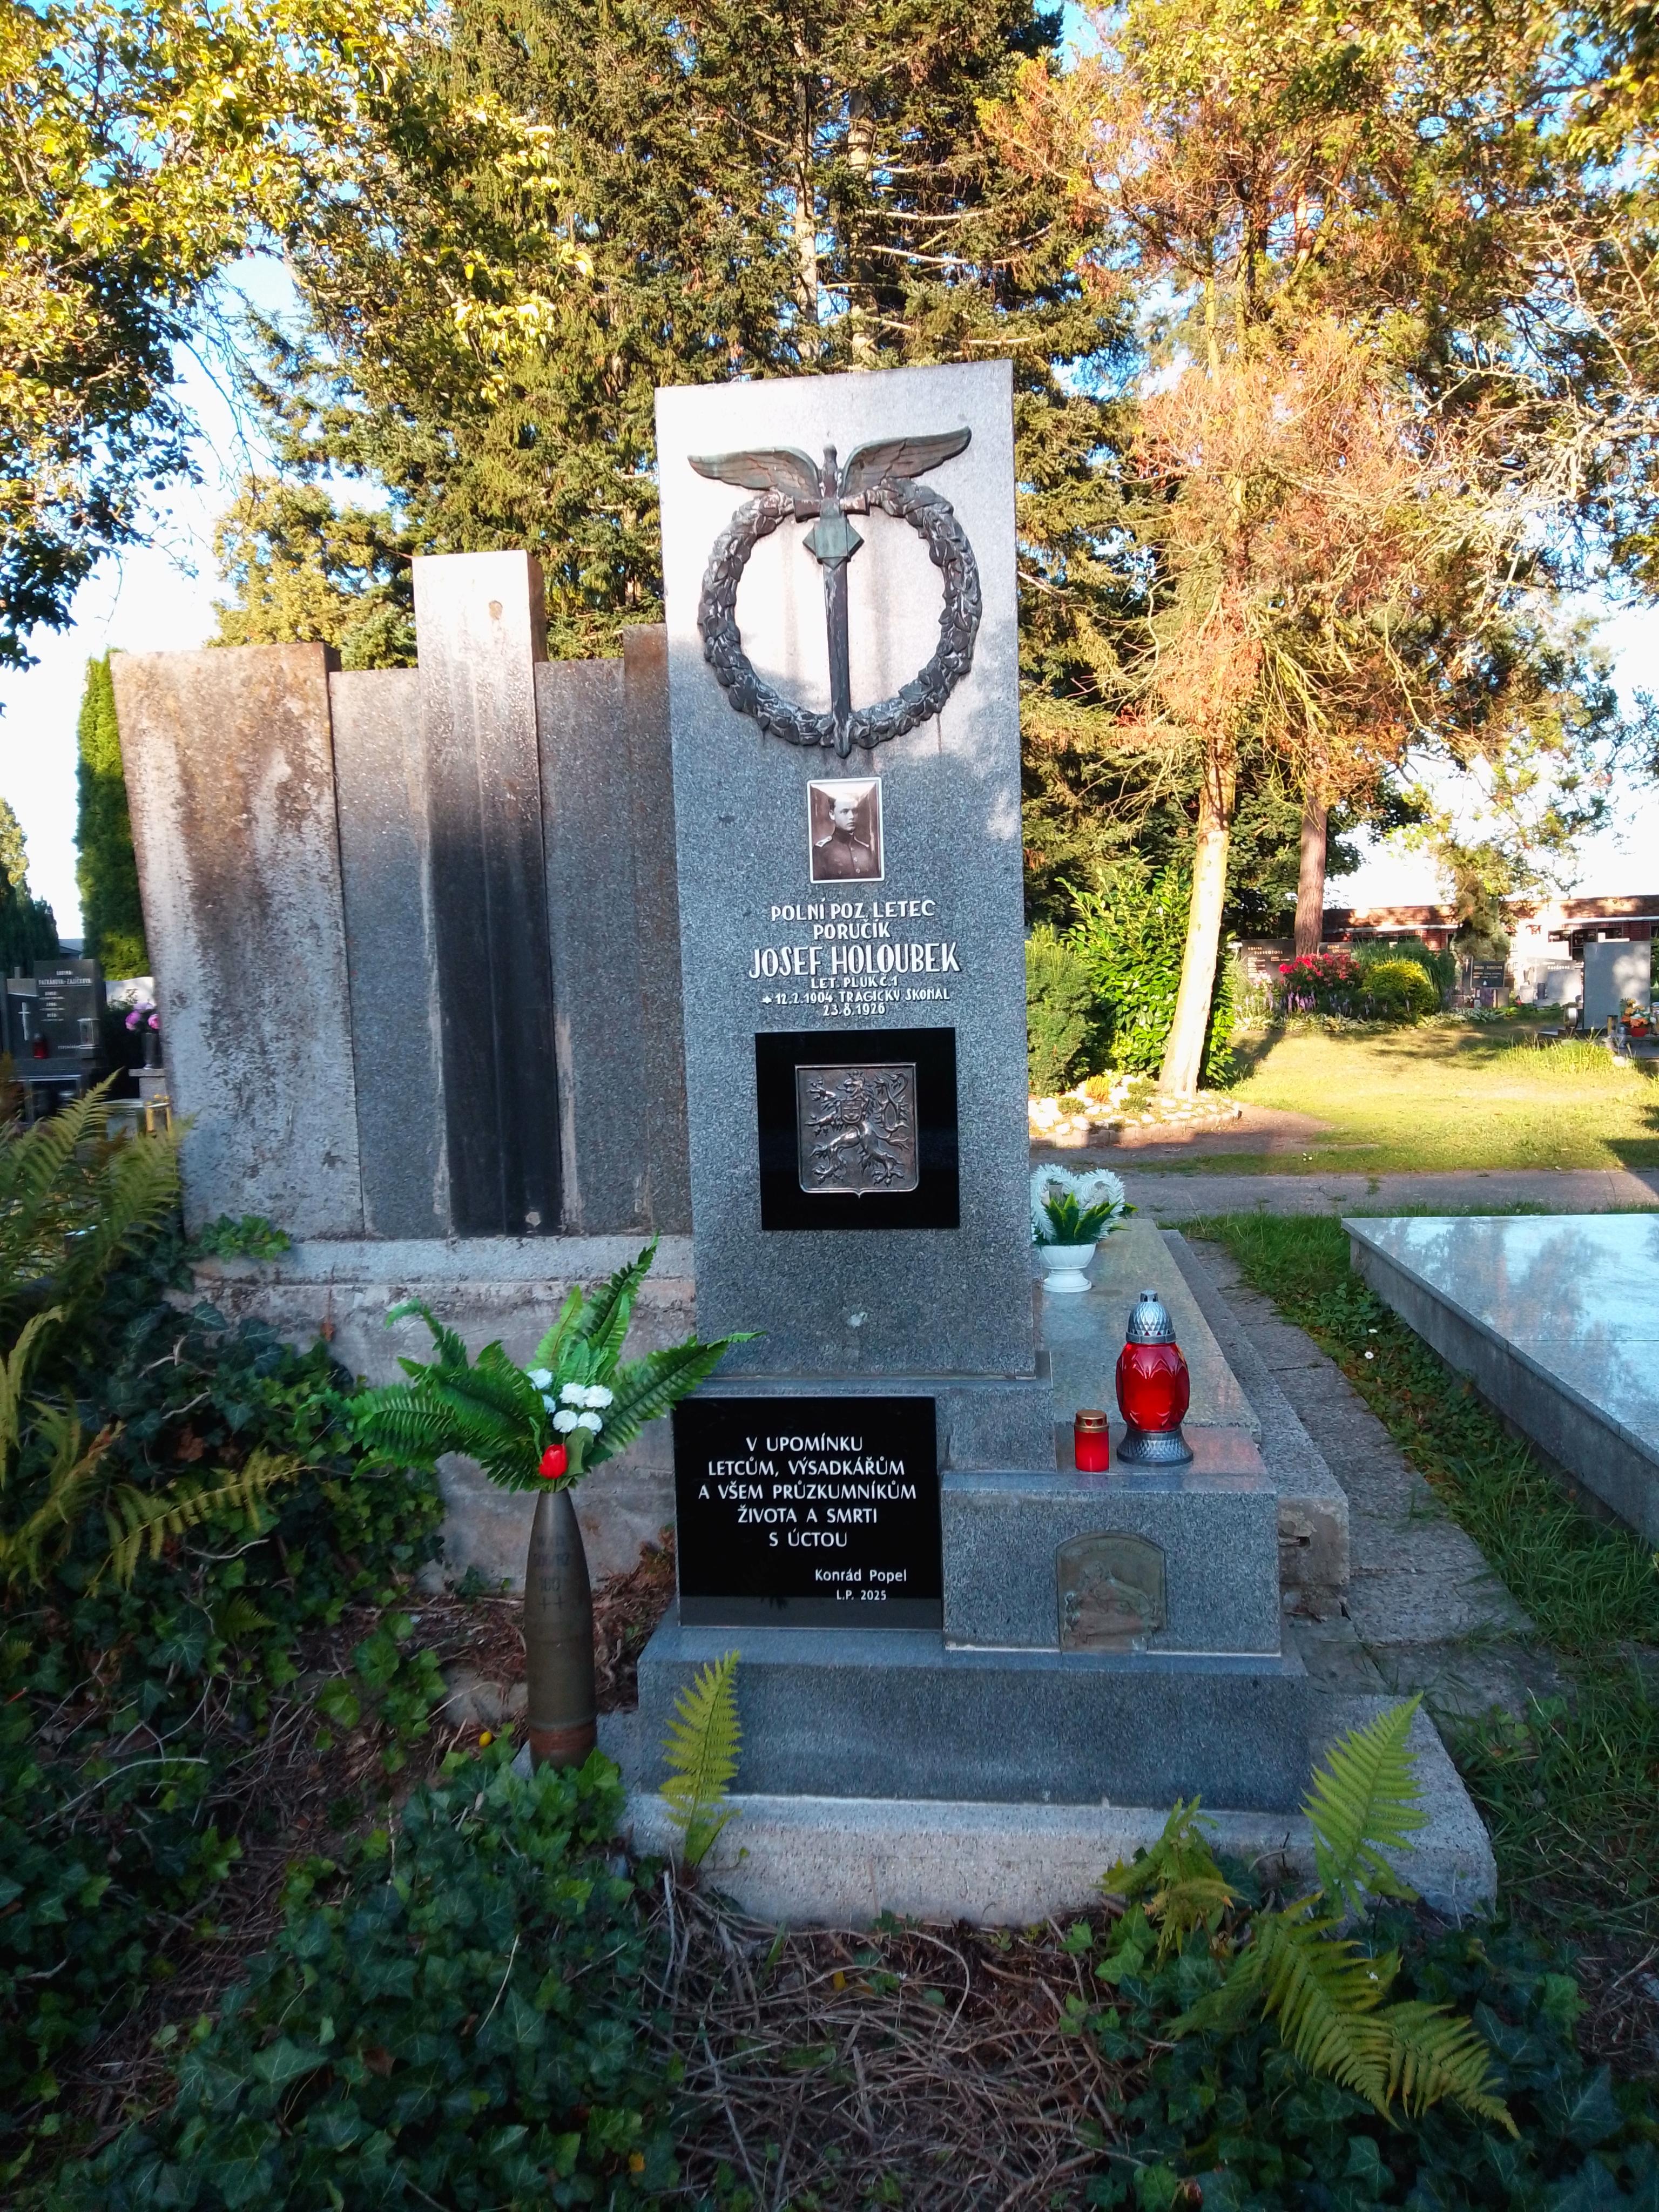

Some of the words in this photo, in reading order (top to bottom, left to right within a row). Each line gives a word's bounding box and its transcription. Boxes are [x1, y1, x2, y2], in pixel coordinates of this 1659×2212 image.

[771, 898, 826, 921] POLNÍ
[873, 900, 936, 918] LETEC
[813, 919, 891, 940] PORUČÍK
[749, 946, 823, 979] JOSEF
[832, 942, 961, 975] HOLOUBEK
[811, 977, 840, 989] LET.
[844, 976, 878, 988] PLUK
[838, 989, 901, 1003] TRAGICKY
[905, 988, 950, 1001] SKONAL
[823, 1003, 886, 1016] 23.8.1926
[746, 1437, 758, 1452] V
[766, 1432, 863, 1452] UPOMÍNKU
[709, 1456, 779, 1477] LETCŮM,
[788, 1456, 905, 1475] VÝSADKÁŘŮM
[698, 1485, 710, 1499] A
[718, 1480, 763, 1499] VŠEM
[773, 1480, 916, 1500] PRŮZKUMNÍKŮM
[737, 1504, 797, 1523] ŽIVOTA
[806, 1508, 818, 1523] A
[826, 1508, 877, 1523] SMRTI
[769, 1532, 778, 1547] S
[788, 1528, 847, 1547] ÚCTOU
[815, 1568, 862, 1582] Konrád
[869, 1569, 907, 1584] Popel
[837, 1589, 854, 1601] L.P.
[860, 1589, 887, 1601] 2025
